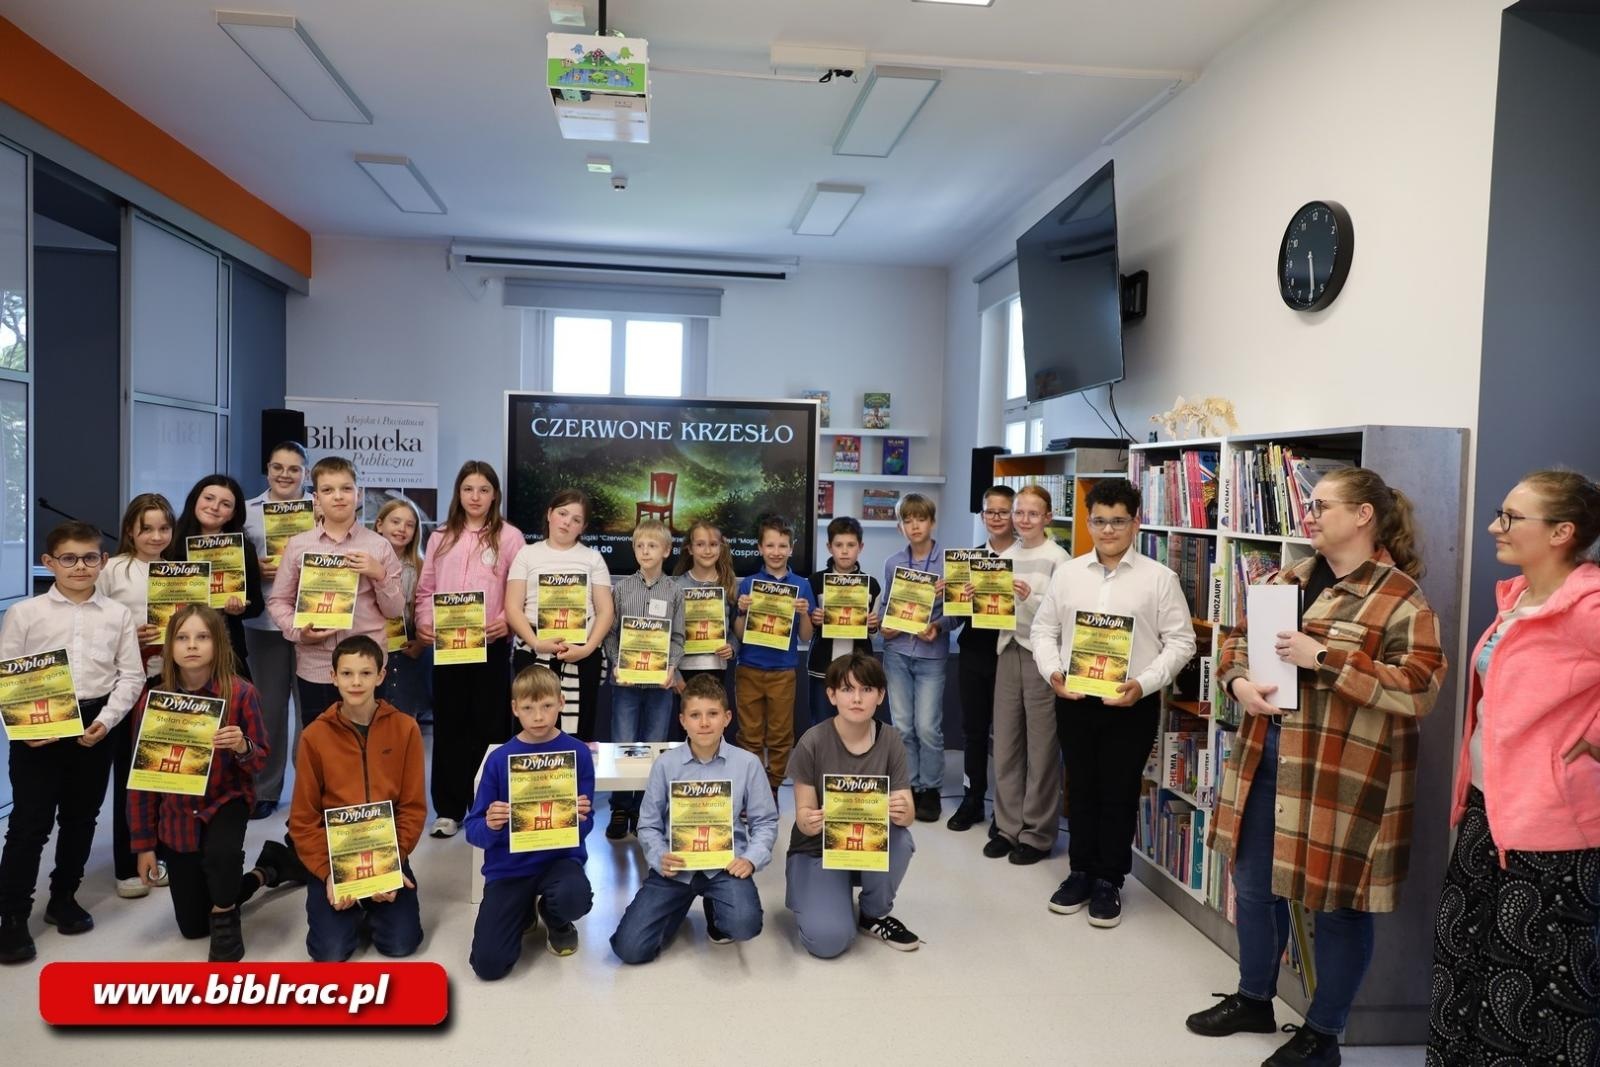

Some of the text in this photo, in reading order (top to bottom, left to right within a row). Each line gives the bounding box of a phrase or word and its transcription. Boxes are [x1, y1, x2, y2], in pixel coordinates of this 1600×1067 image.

[531, 418, 794, 444] CZERWONE KRZESŁO
[305, 426, 422, 452] Biblioteka
[352, 452, 415, 469] Publiczna
[272, 503, 305, 513] Dyplom
[196, 536, 233, 548] Dyplom
[314, 556, 347, 567] Dyplo
[977, 560, 1006, 571] Dyplom
[160, 564, 200, 575] Dyplom
[547, 575, 580, 586] Dyplom
[832, 575, 862, 584] Dyplom
[902, 571, 931, 583] Dyplom
[687, 590, 716, 600] Dyplom
[760, 583, 791, 596] Dyplom
[442, 594, 476, 605] Dyplom
[1213, 578, 1221, 623] DINOZAURY
[631, 619, 663, 630] Dyplom
[1086, 614, 1124, 628] Dyplom
[7, 656, 56, 673] Dyplom
[162, 697, 211, 713] Dyplom
[522, 756, 565, 770] Dyplom
[682, 784, 722, 796] Dyplom
[836, 779, 878, 791] Dyplom
[339, 808, 381, 823] Dyplom
